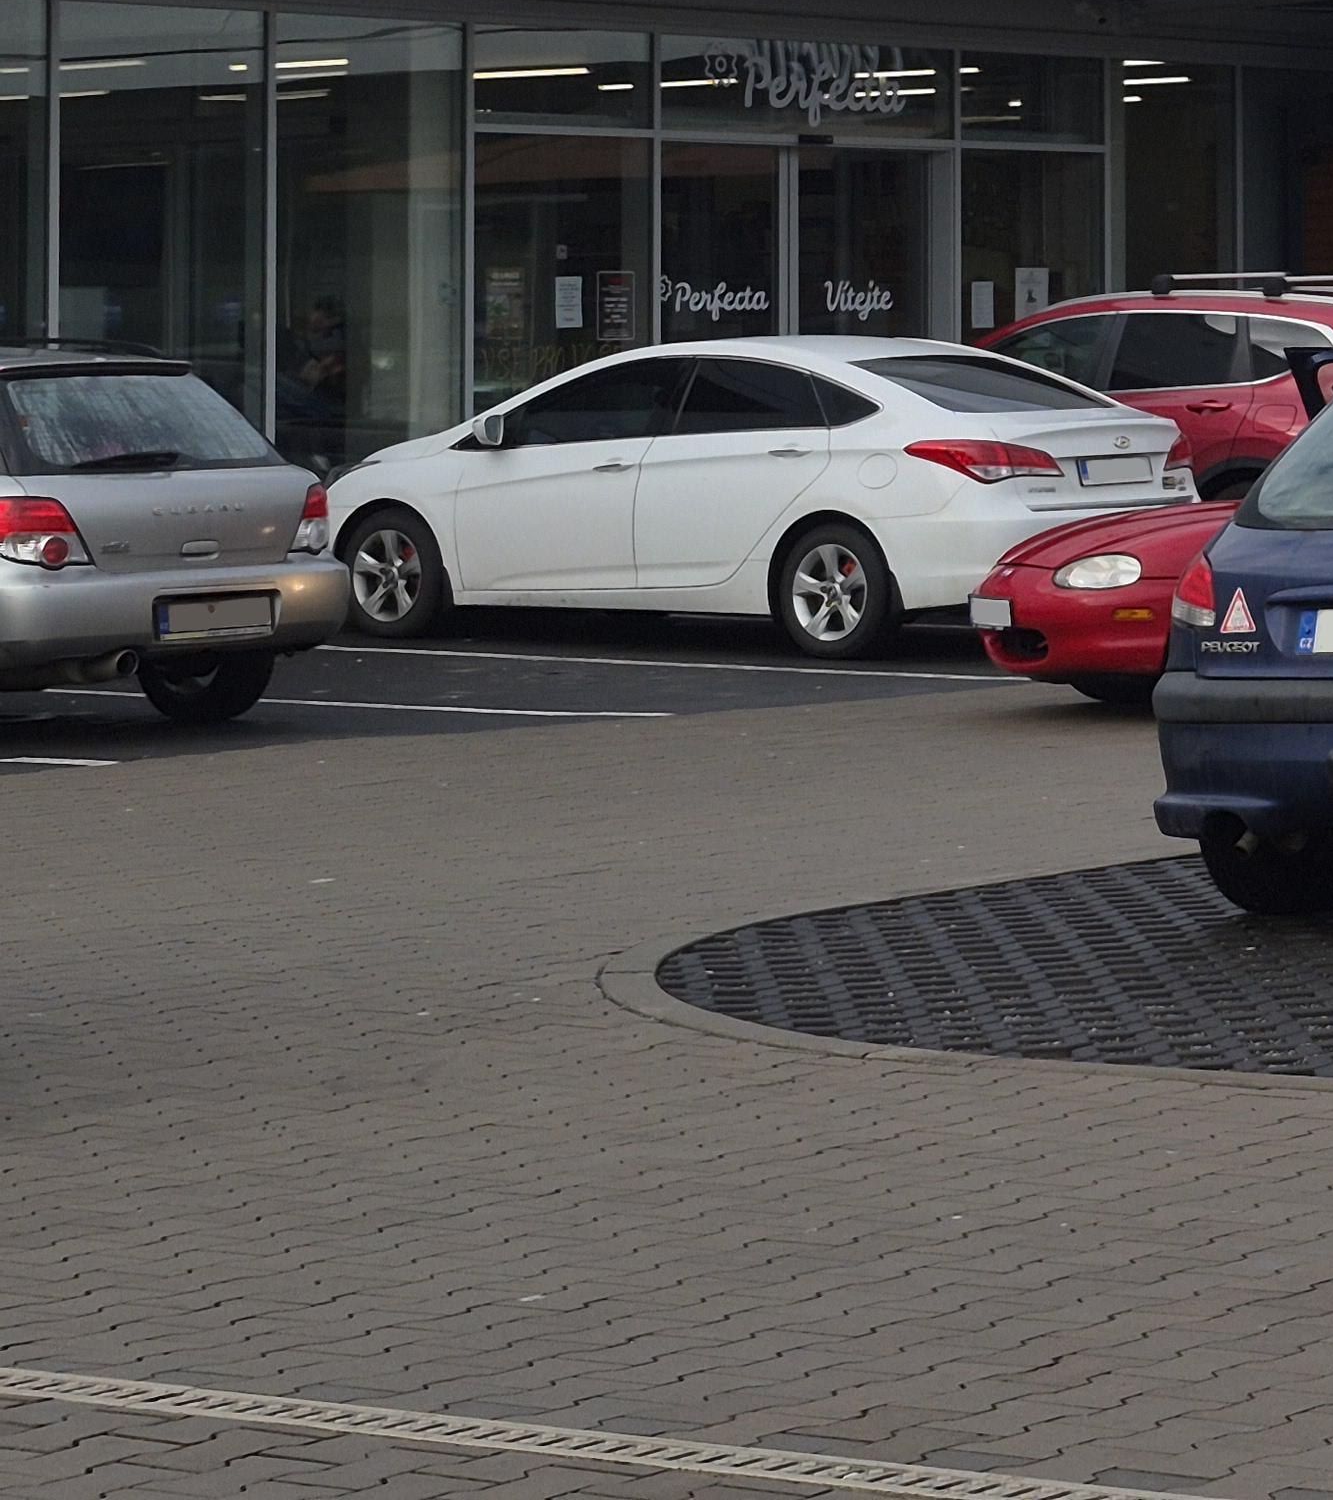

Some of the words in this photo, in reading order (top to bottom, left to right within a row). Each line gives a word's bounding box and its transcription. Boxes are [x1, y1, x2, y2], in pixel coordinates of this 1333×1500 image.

[743, 55, 906, 127] Perfecta
[675, 282, 769, 321] Perfecta
[824, 280, 893, 321] Vítejte
[1201, 641, 1261, 653] PEUGEOT
